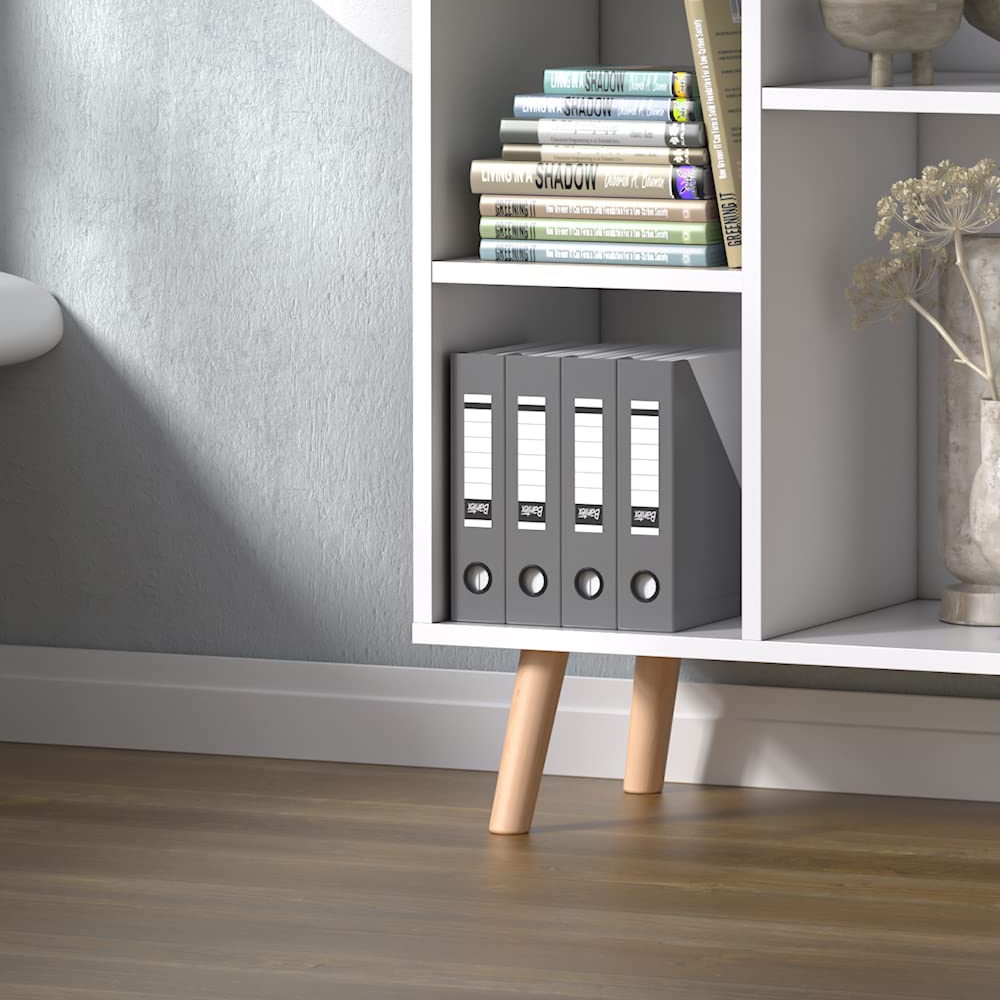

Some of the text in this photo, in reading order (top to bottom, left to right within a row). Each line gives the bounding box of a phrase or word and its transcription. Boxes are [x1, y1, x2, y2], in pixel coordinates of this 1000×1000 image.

[585, 71, 625, 92] SHADOW
[563, 97, 613, 117] SHADOW
[481, 168, 512, 183] LIVING
[513, 170, 525, 183] IN
[526, 170, 533, 184] A
[534, 162, 599, 190] SHADOW
[721, 202, 742, 247] GREENING
